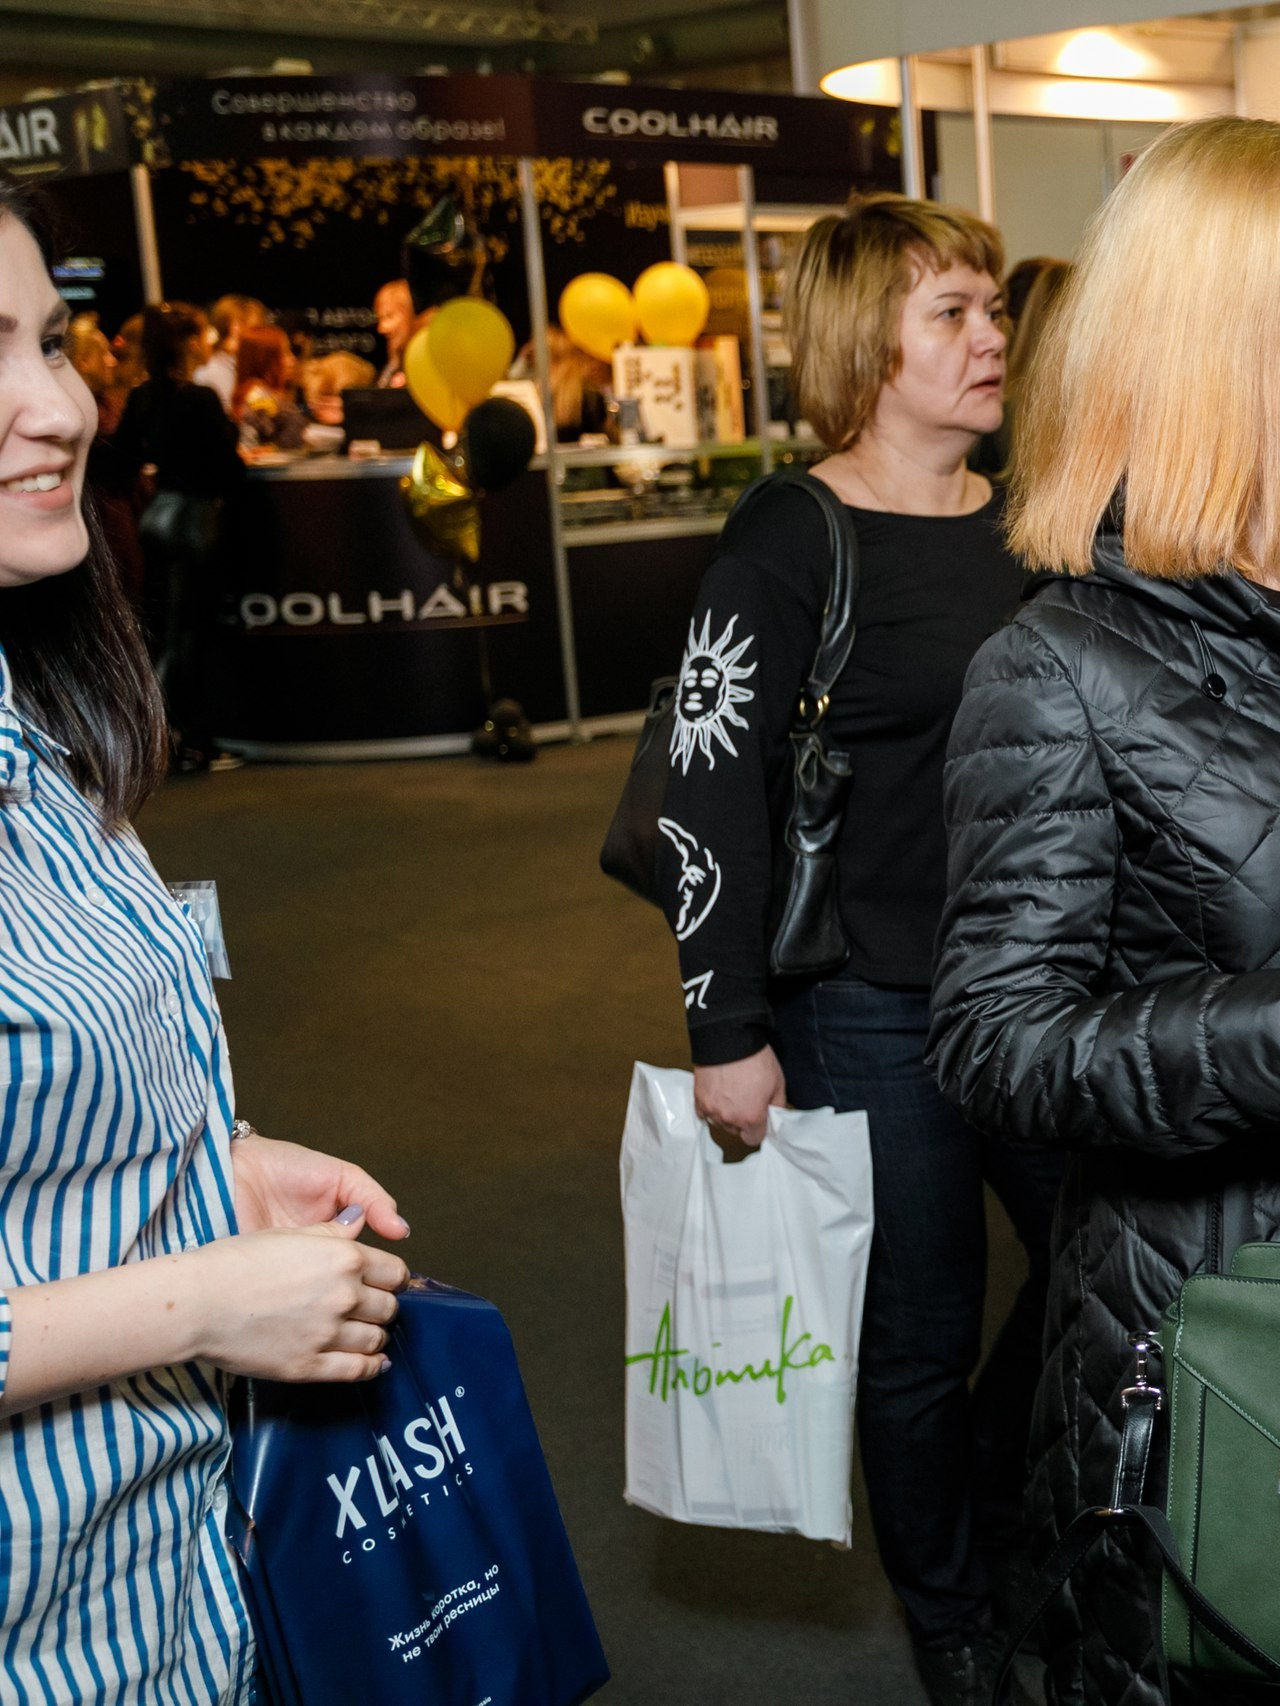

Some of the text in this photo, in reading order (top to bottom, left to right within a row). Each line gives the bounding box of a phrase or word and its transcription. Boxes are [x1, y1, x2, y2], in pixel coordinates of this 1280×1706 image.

[211, 88, 417, 115] Совершенство
[582, 106, 779, 141] COOLHAIR
[326, 1395, 466, 1539] XLASH
[388, 1564, 499, 1652] Жизнь коротка, но
[402, 1583, 500, 1663] не твои ресницы
